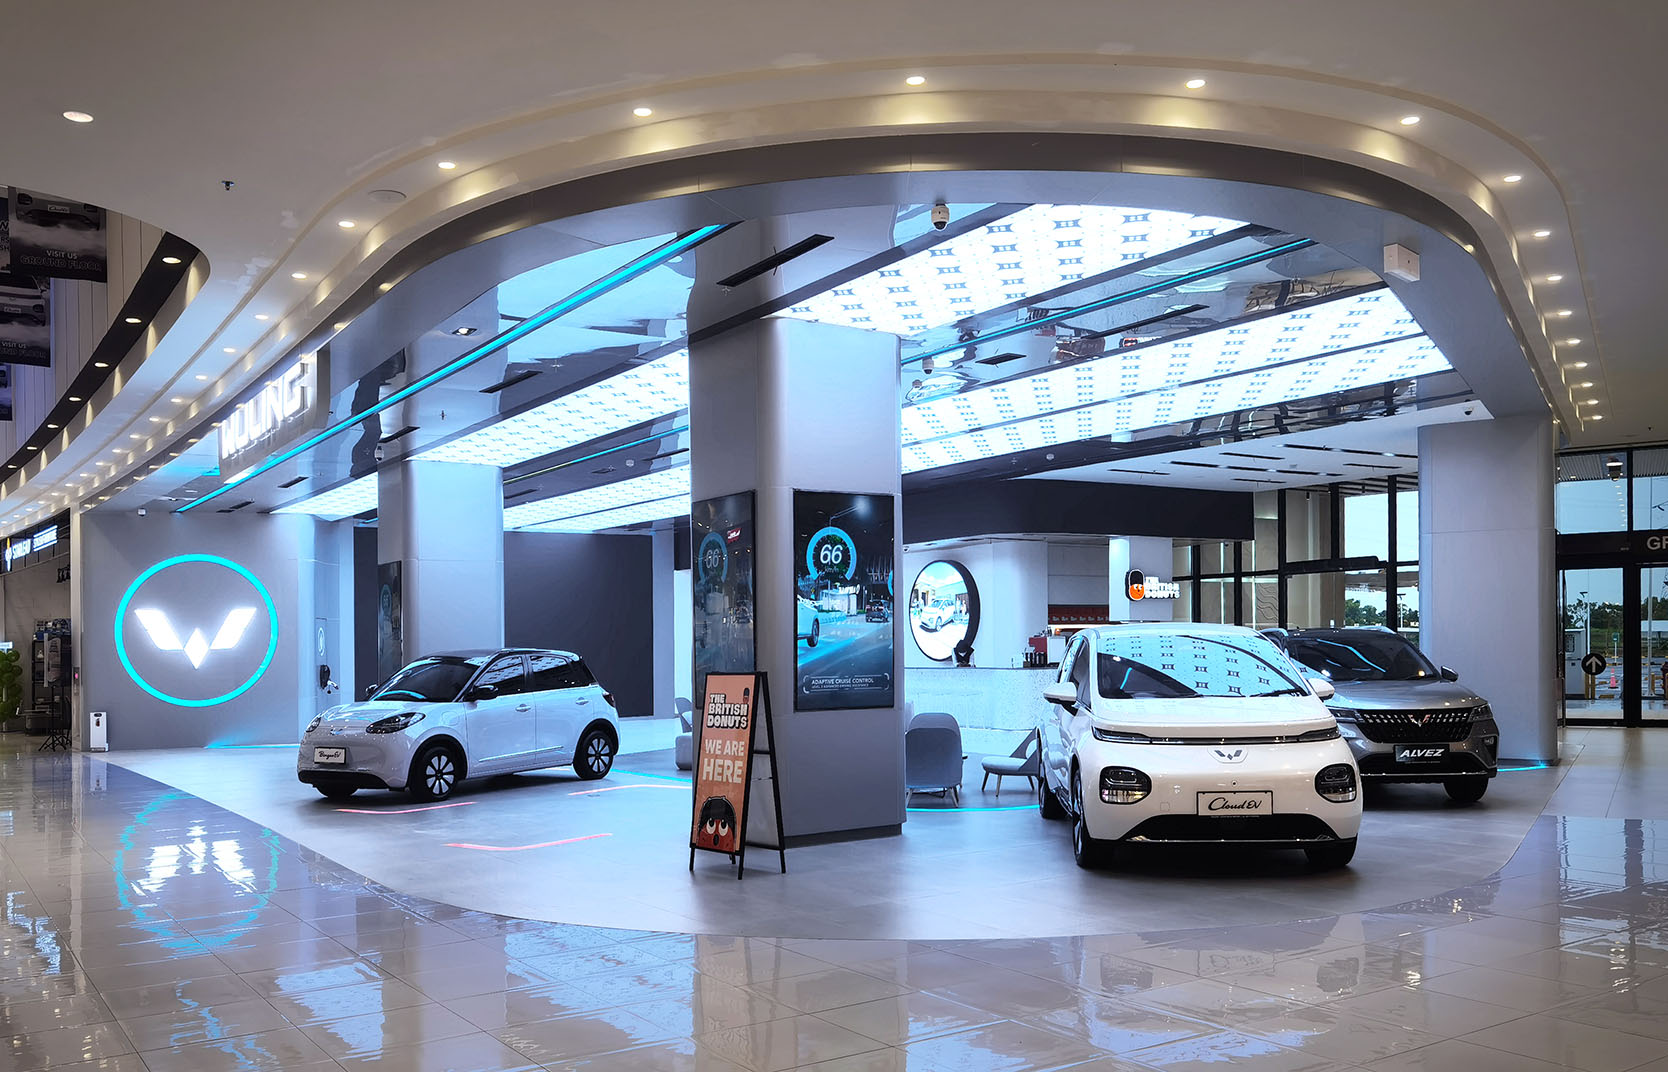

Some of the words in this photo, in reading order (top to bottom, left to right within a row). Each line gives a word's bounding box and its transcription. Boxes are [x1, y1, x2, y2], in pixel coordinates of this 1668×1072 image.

[46, 250, 65, 258] VISIT
[67, 252, 77, 260] US
[820, 544, 843, 564] 66
[709, 694, 726, 704] THE
[708, 703, 749, 716] BRITISH
[706, 714, 748, 728] DONUTS
[705, 739, 722, 755] WE
[723, 740, 745, 757] ARE
[1400, 748, 1445, 758] ALVEZ
[702, 758, 743, 783] HERE
